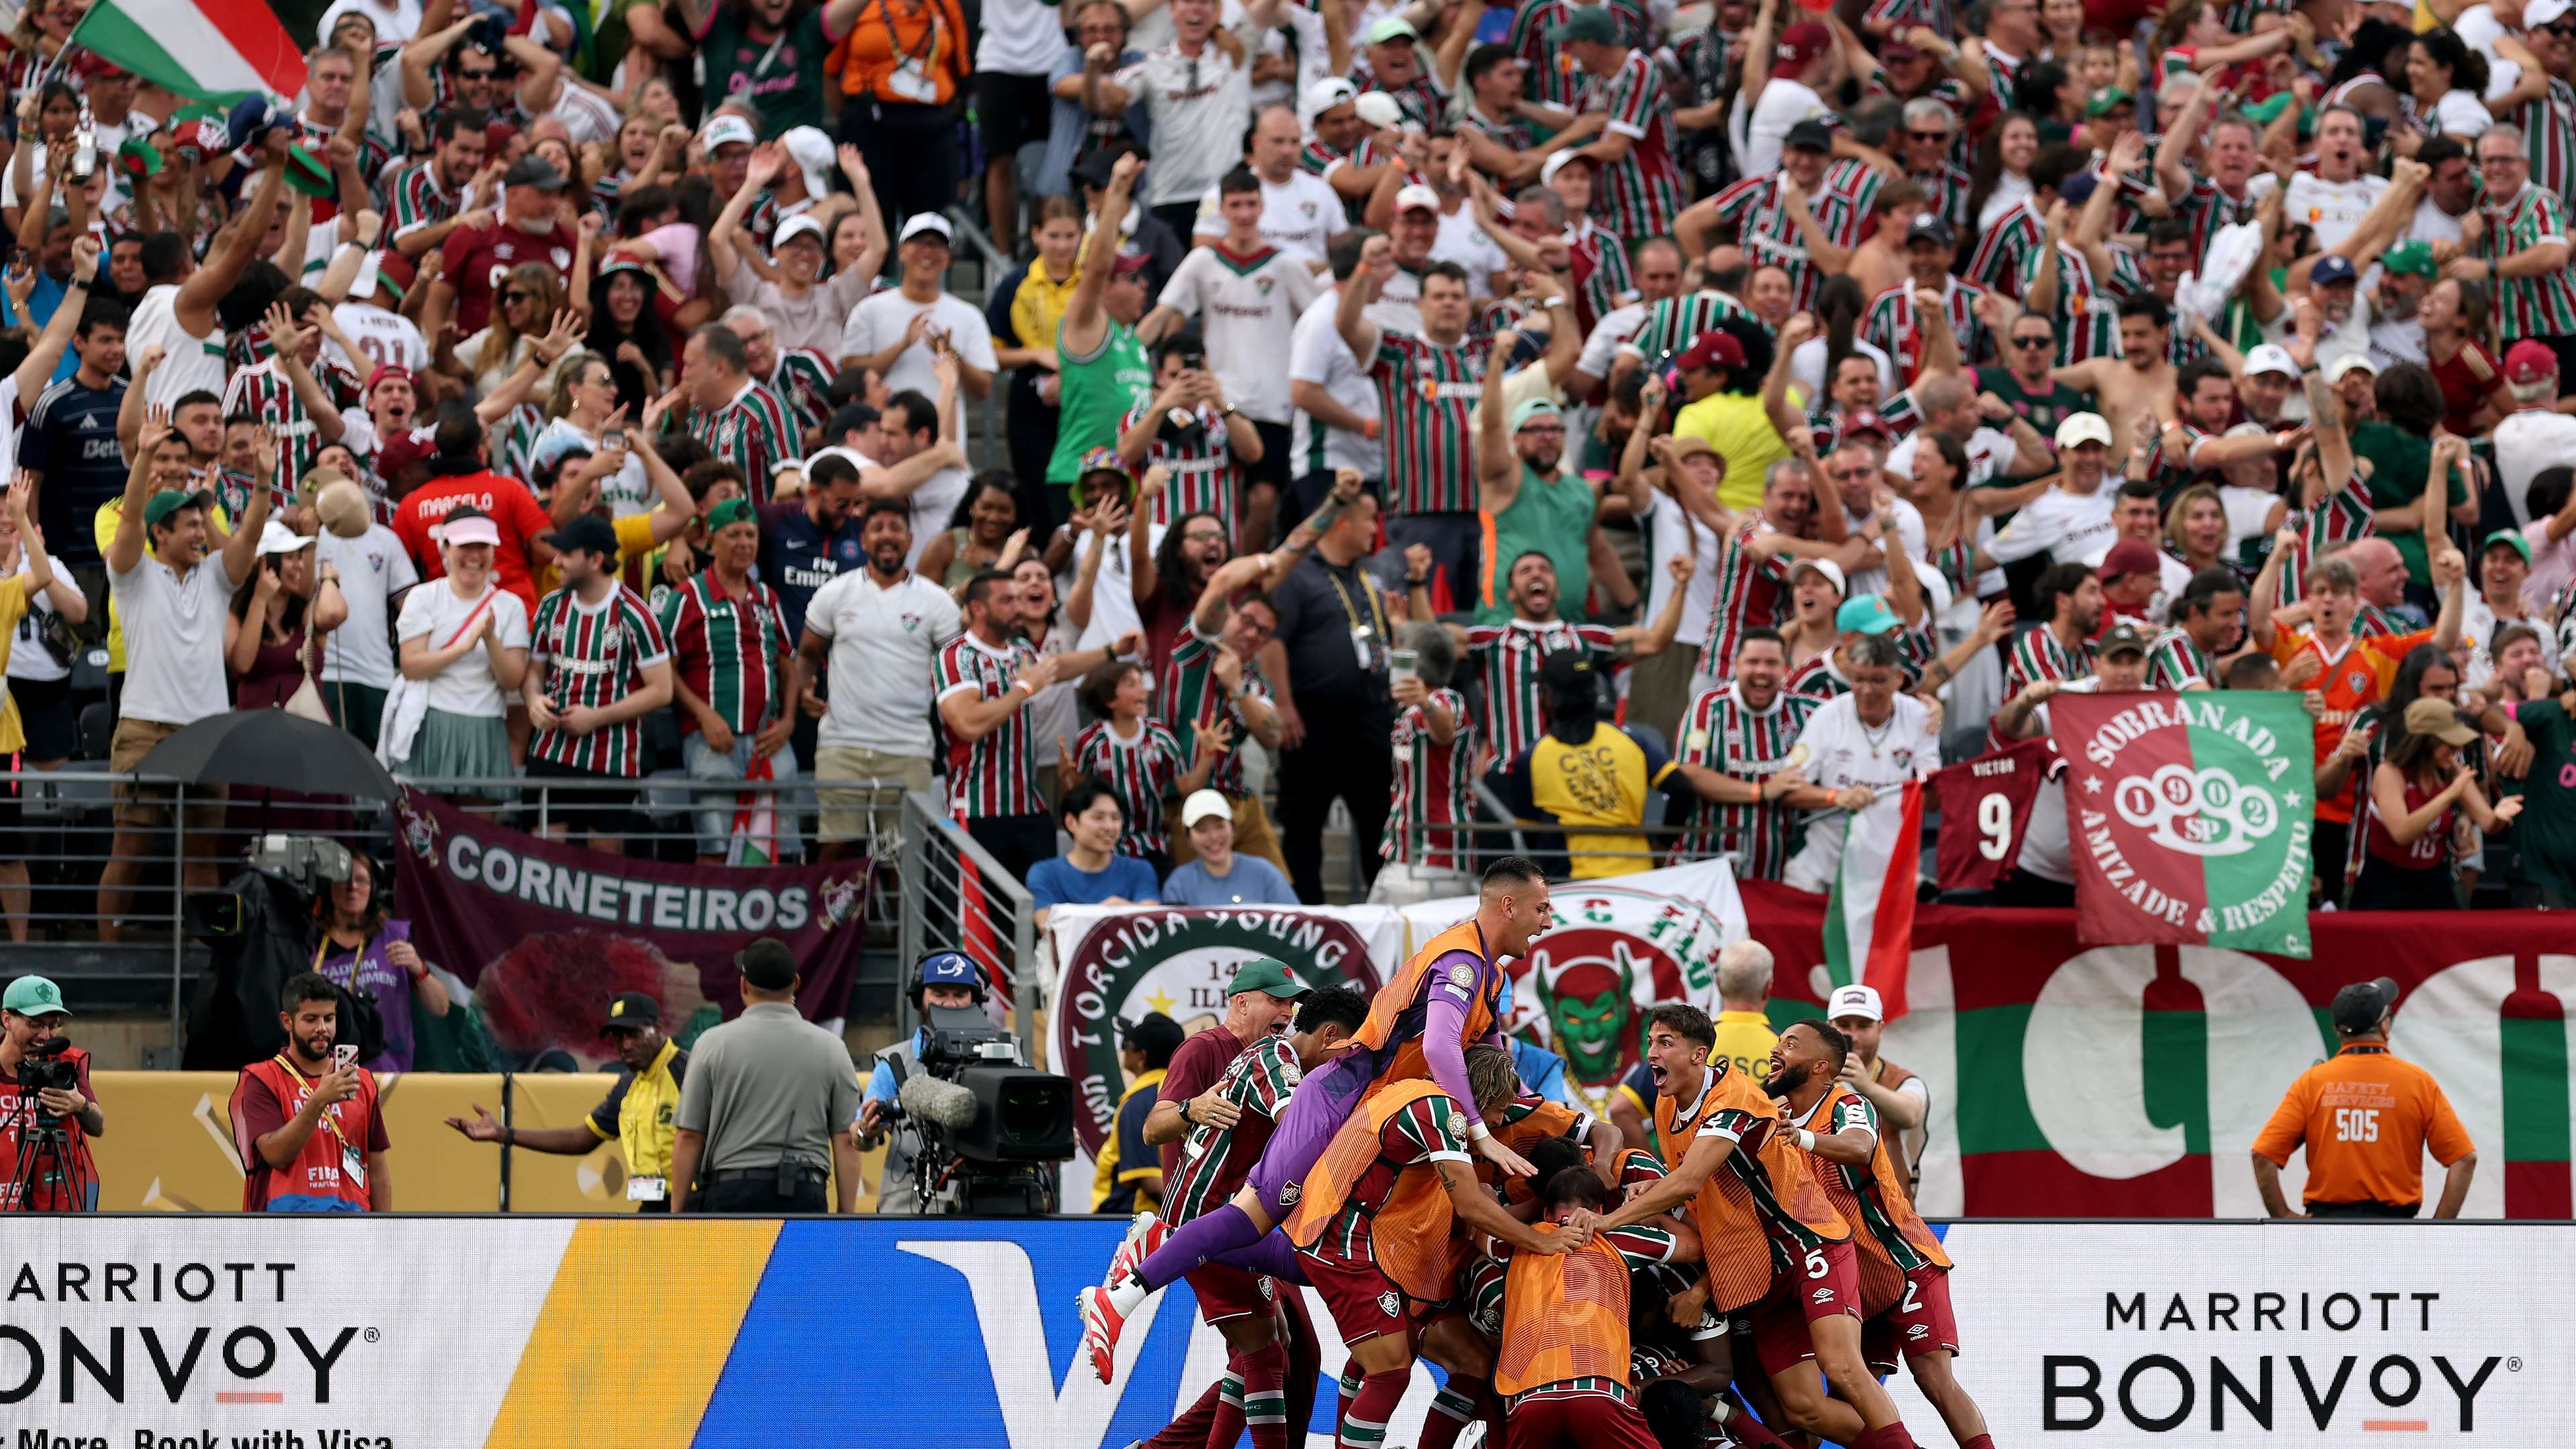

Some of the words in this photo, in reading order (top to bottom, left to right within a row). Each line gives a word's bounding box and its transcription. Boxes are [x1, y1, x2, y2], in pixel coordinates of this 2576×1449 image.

[2085, 696, 2291, 782] SOBRANADA
[1972, 757, 2015, 777] VICTOR
[1978, 792, 2012, 861] 9
[2184, 818, 2221, 843] SP
[447, 835, 809, 931] CORNETEIROS
[2081, 808, 2190, 927] AMIZADE
[2221, 820, 2310, 932] RESPEITO
[1071, 911, 1191, 1049] TORCIDA
[1205, 910, 1349, 969] YOUNG
[2320, 1095, 2396, 1108] SERVICES
[2326, 1081, 2390, 1095] SAFETY
[2335, 1108, 2379, 1142] 505
[1805, 1248, 1829, 1279] 5
[1902, 1280, 1923, 1313] 2
[2106, 1292, 2439, 1331] MARRIOTT
[1910, 1333, 1929, 1341] umbro
